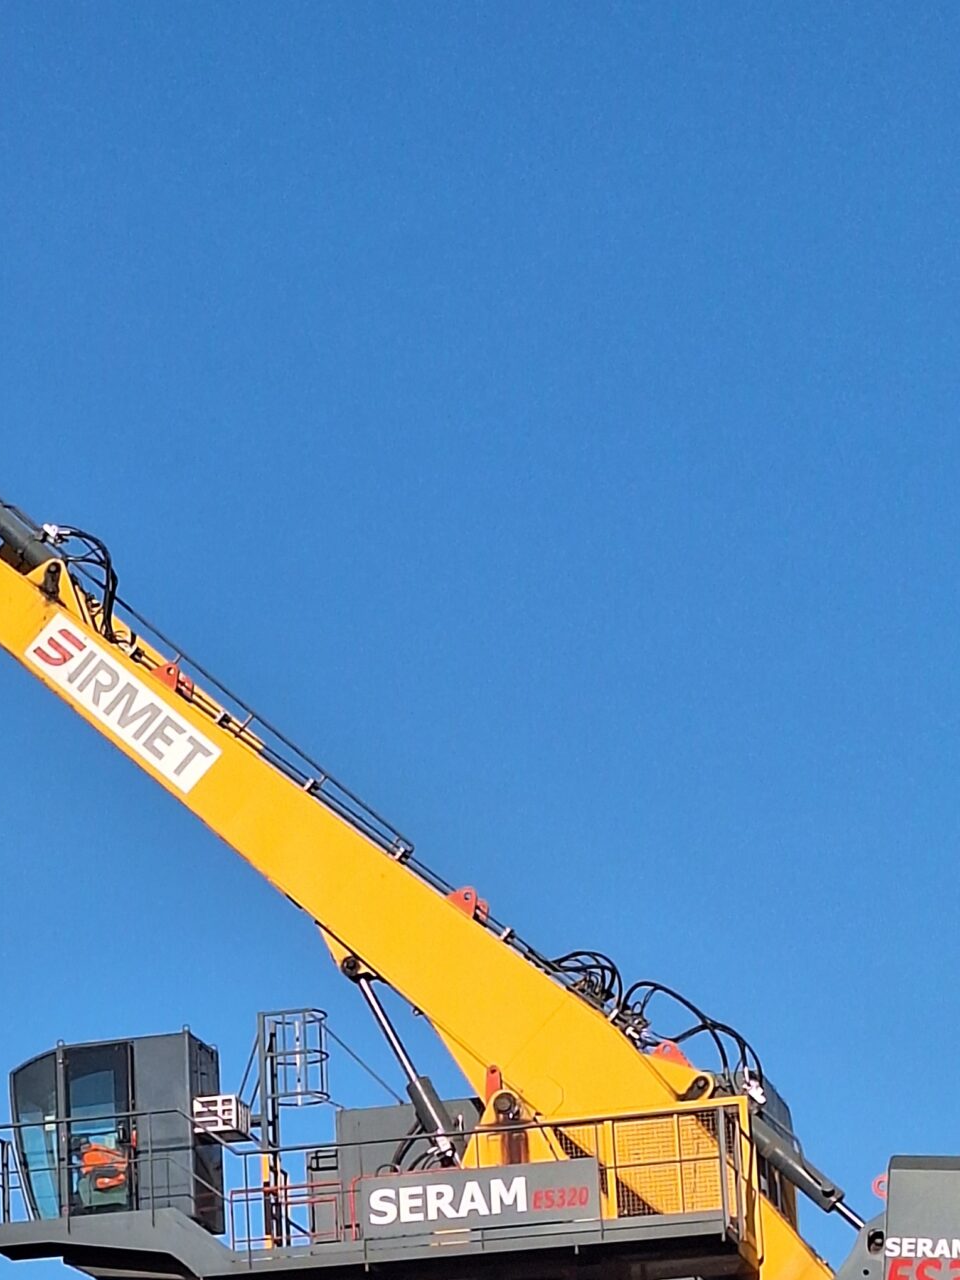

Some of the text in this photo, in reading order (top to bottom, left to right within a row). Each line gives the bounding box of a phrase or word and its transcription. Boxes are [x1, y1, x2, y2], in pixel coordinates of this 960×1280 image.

[32, 628, 214, 777] SIRMET
[368, 1176, 590, 1226] SERAM ES320
